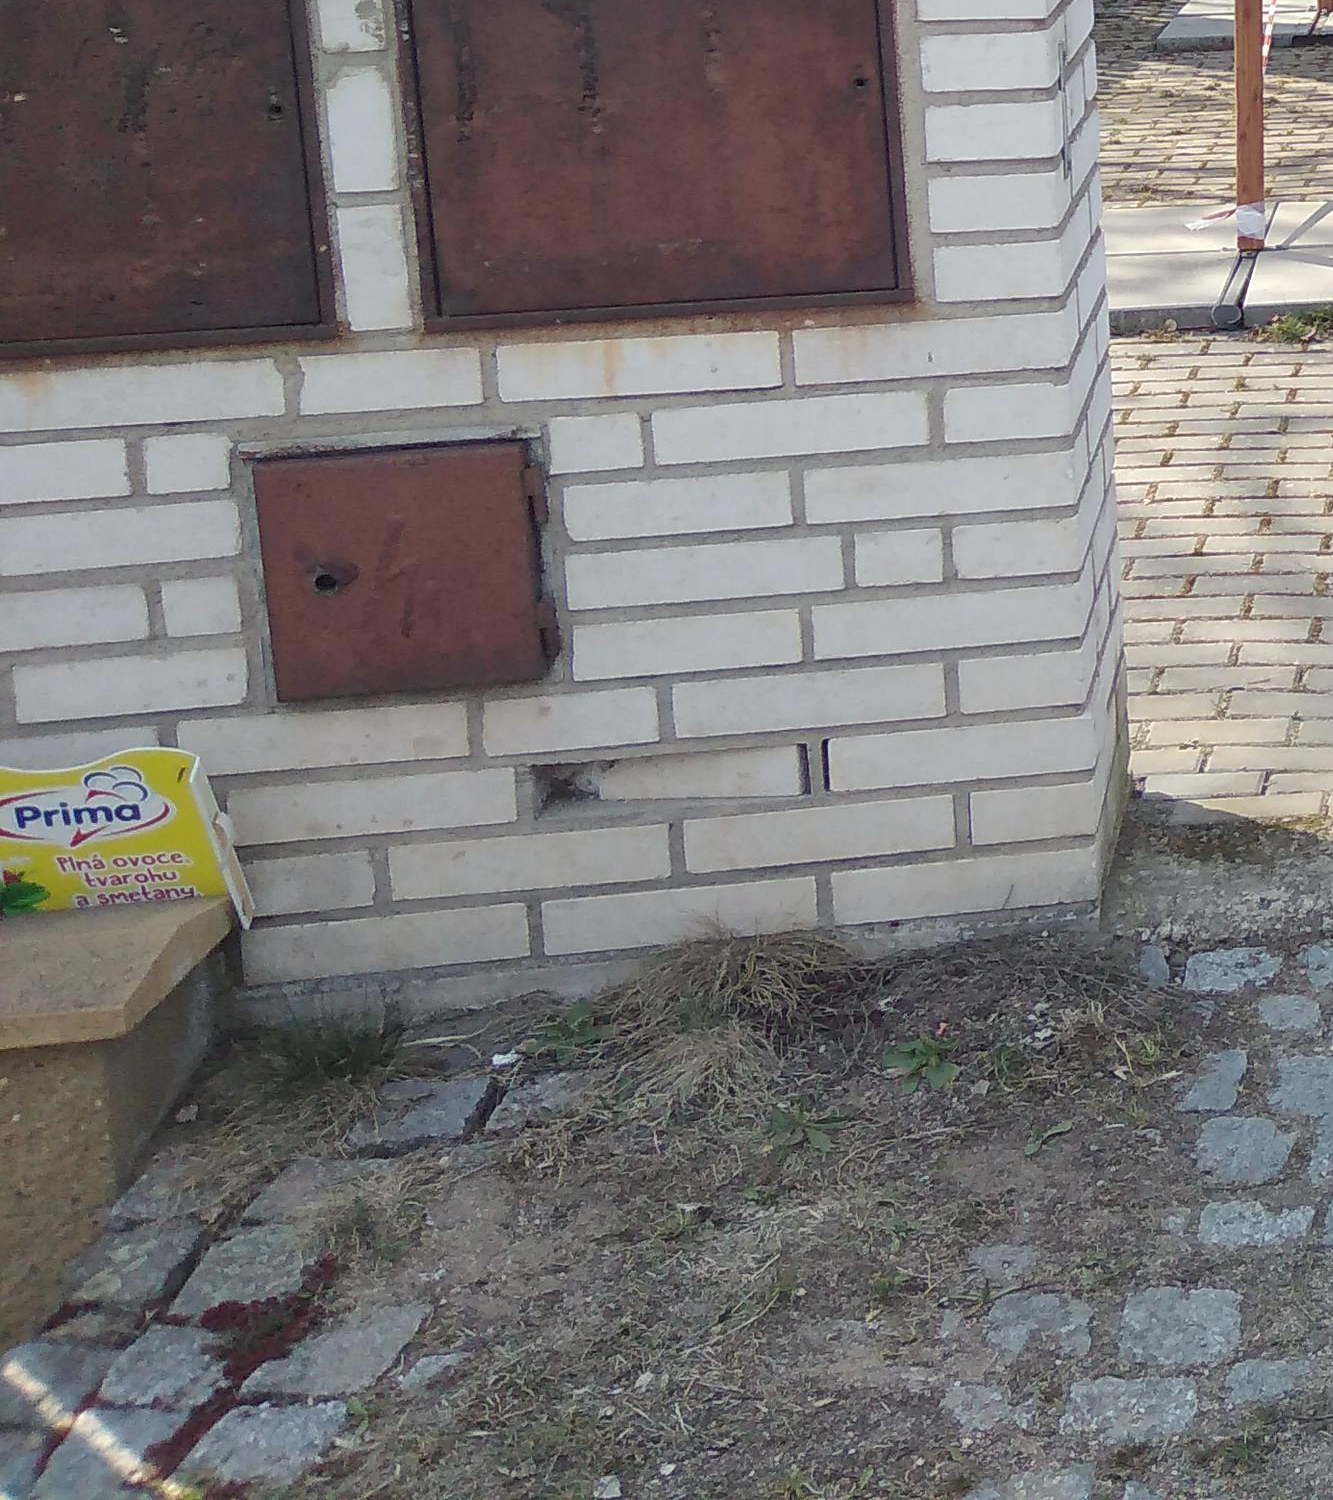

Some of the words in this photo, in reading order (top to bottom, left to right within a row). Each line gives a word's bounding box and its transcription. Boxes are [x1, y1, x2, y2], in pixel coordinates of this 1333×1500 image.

[15, 802, 142, 829] Prima
[56, 854, 106, 873] Plná
[84, 868, 178, 888] tvarohu
[76, 895, 90, 907] a
